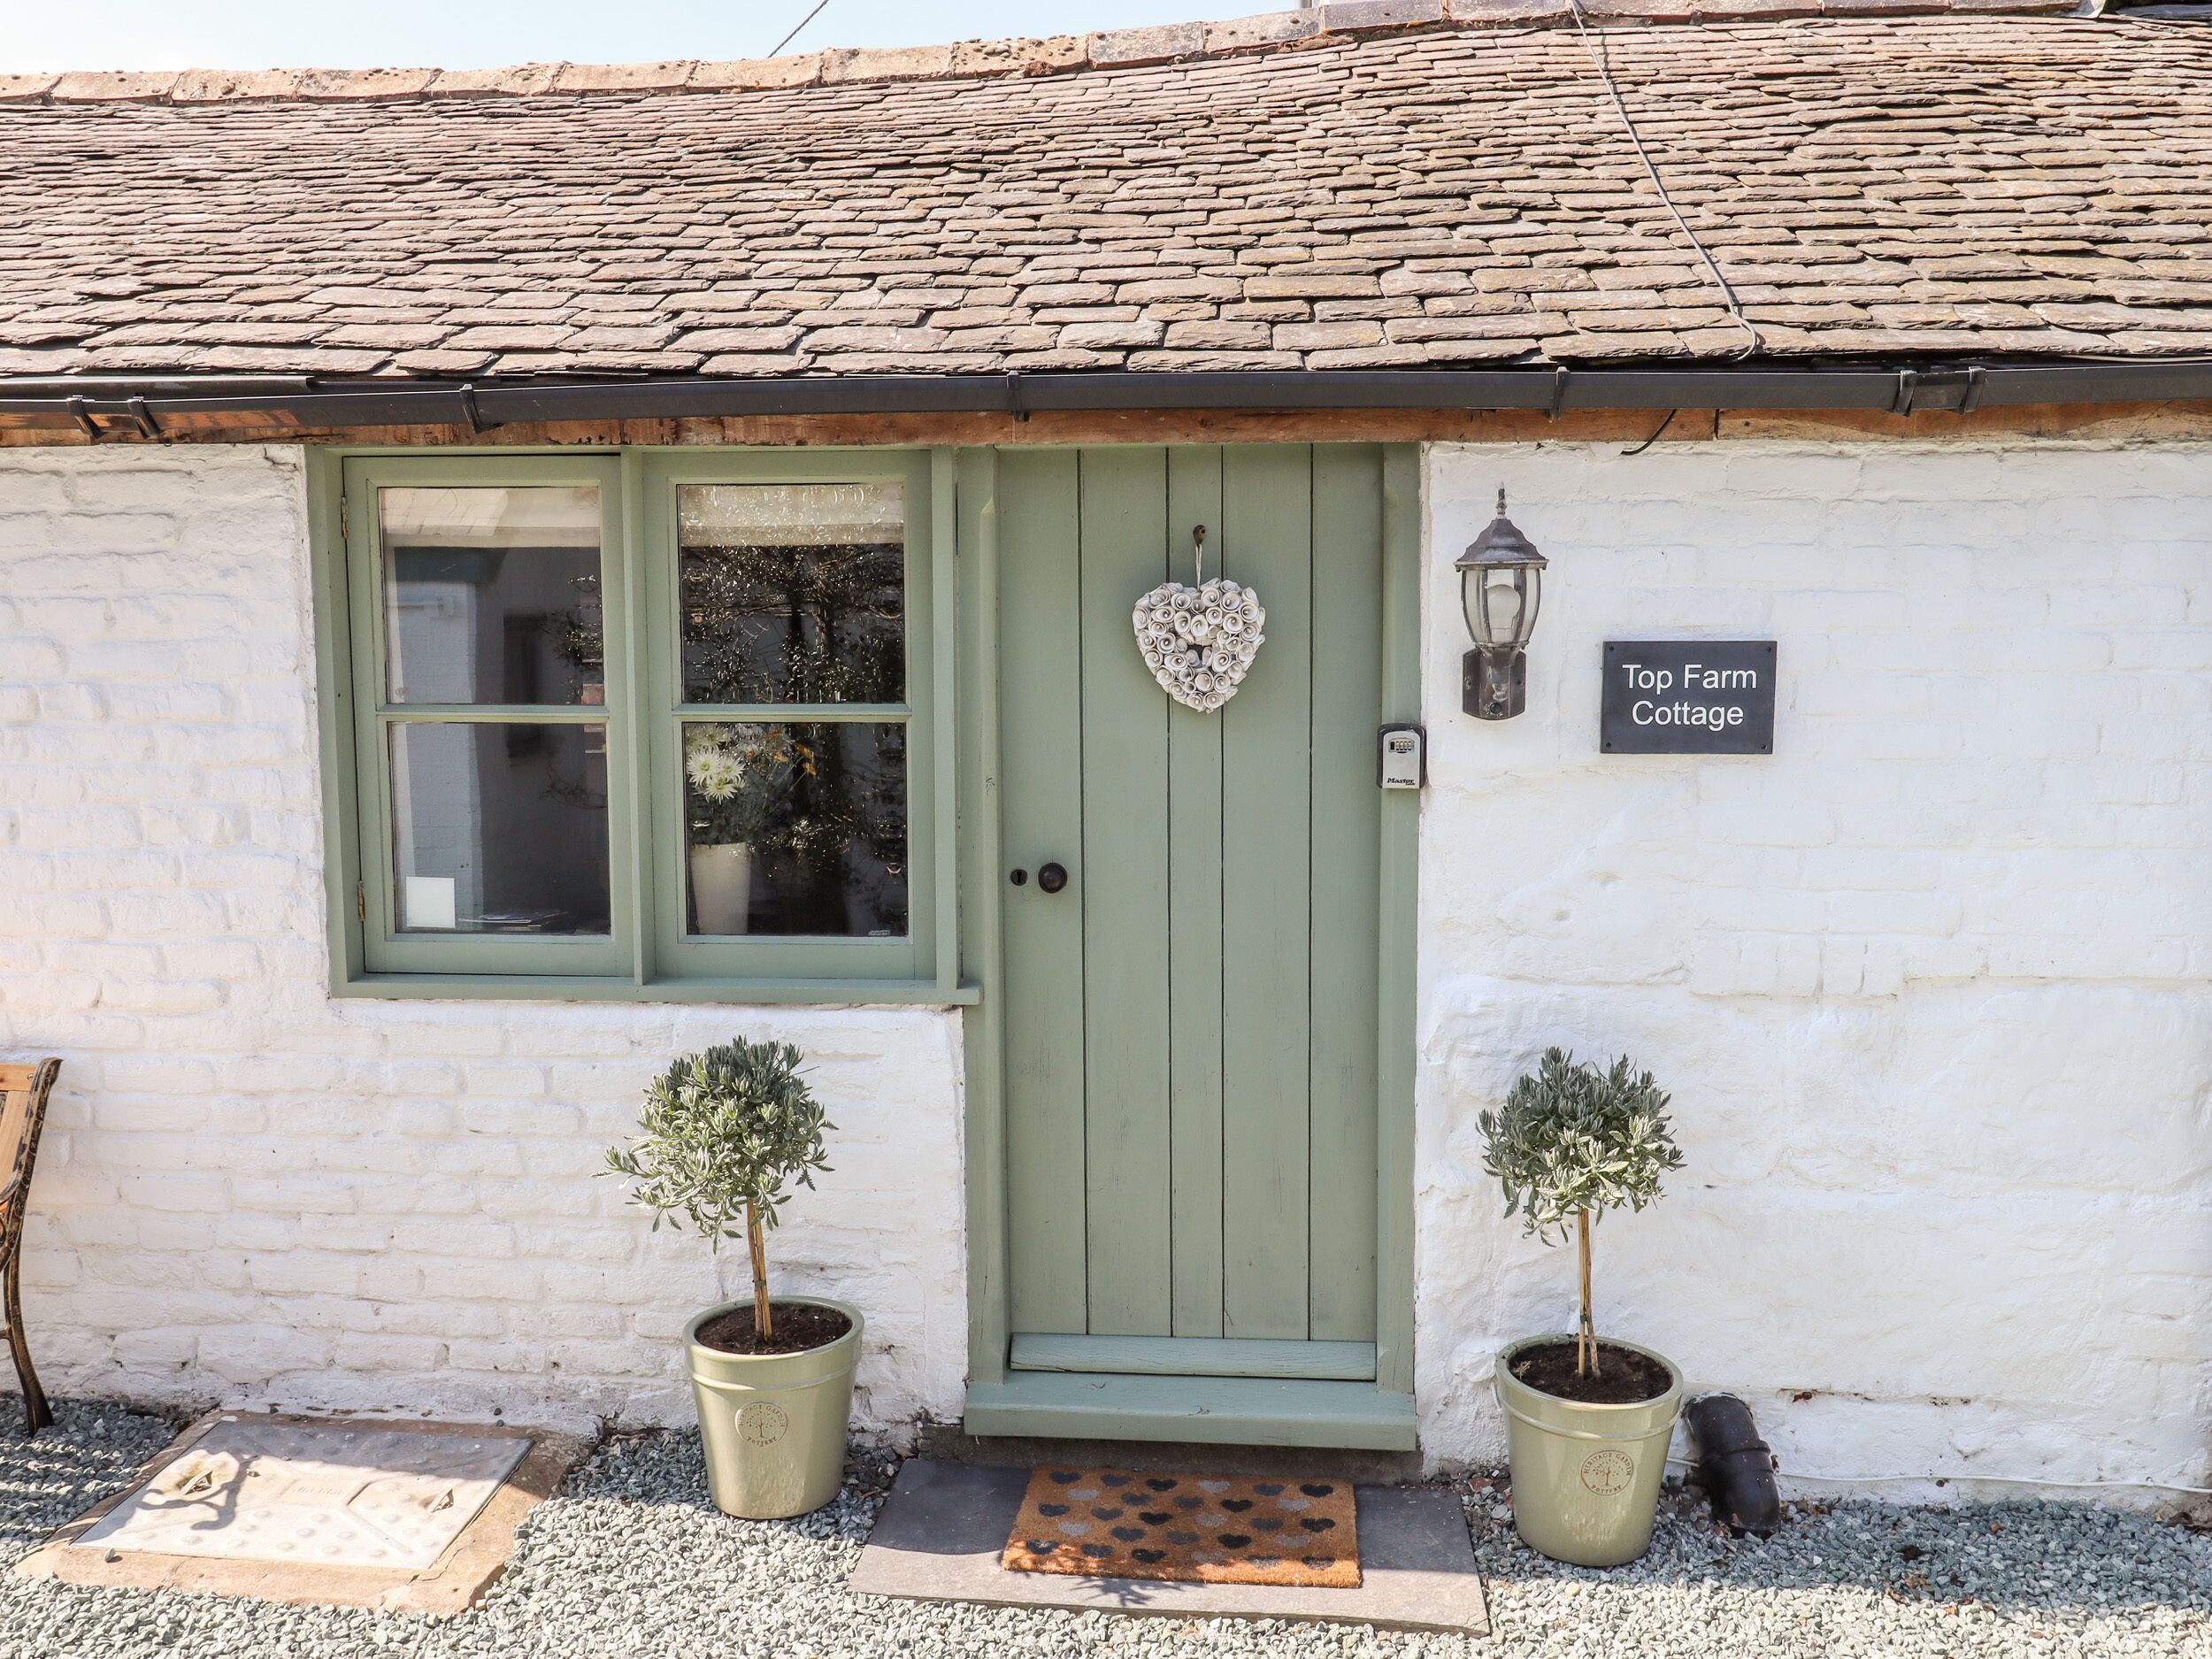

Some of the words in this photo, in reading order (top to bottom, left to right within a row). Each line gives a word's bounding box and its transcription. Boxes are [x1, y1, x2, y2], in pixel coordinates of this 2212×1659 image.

[1622, 664, 1673, 695] Top
[1684, 664, 1757, 689] Farm
[1632, 700, 1744, 732] Cottage
